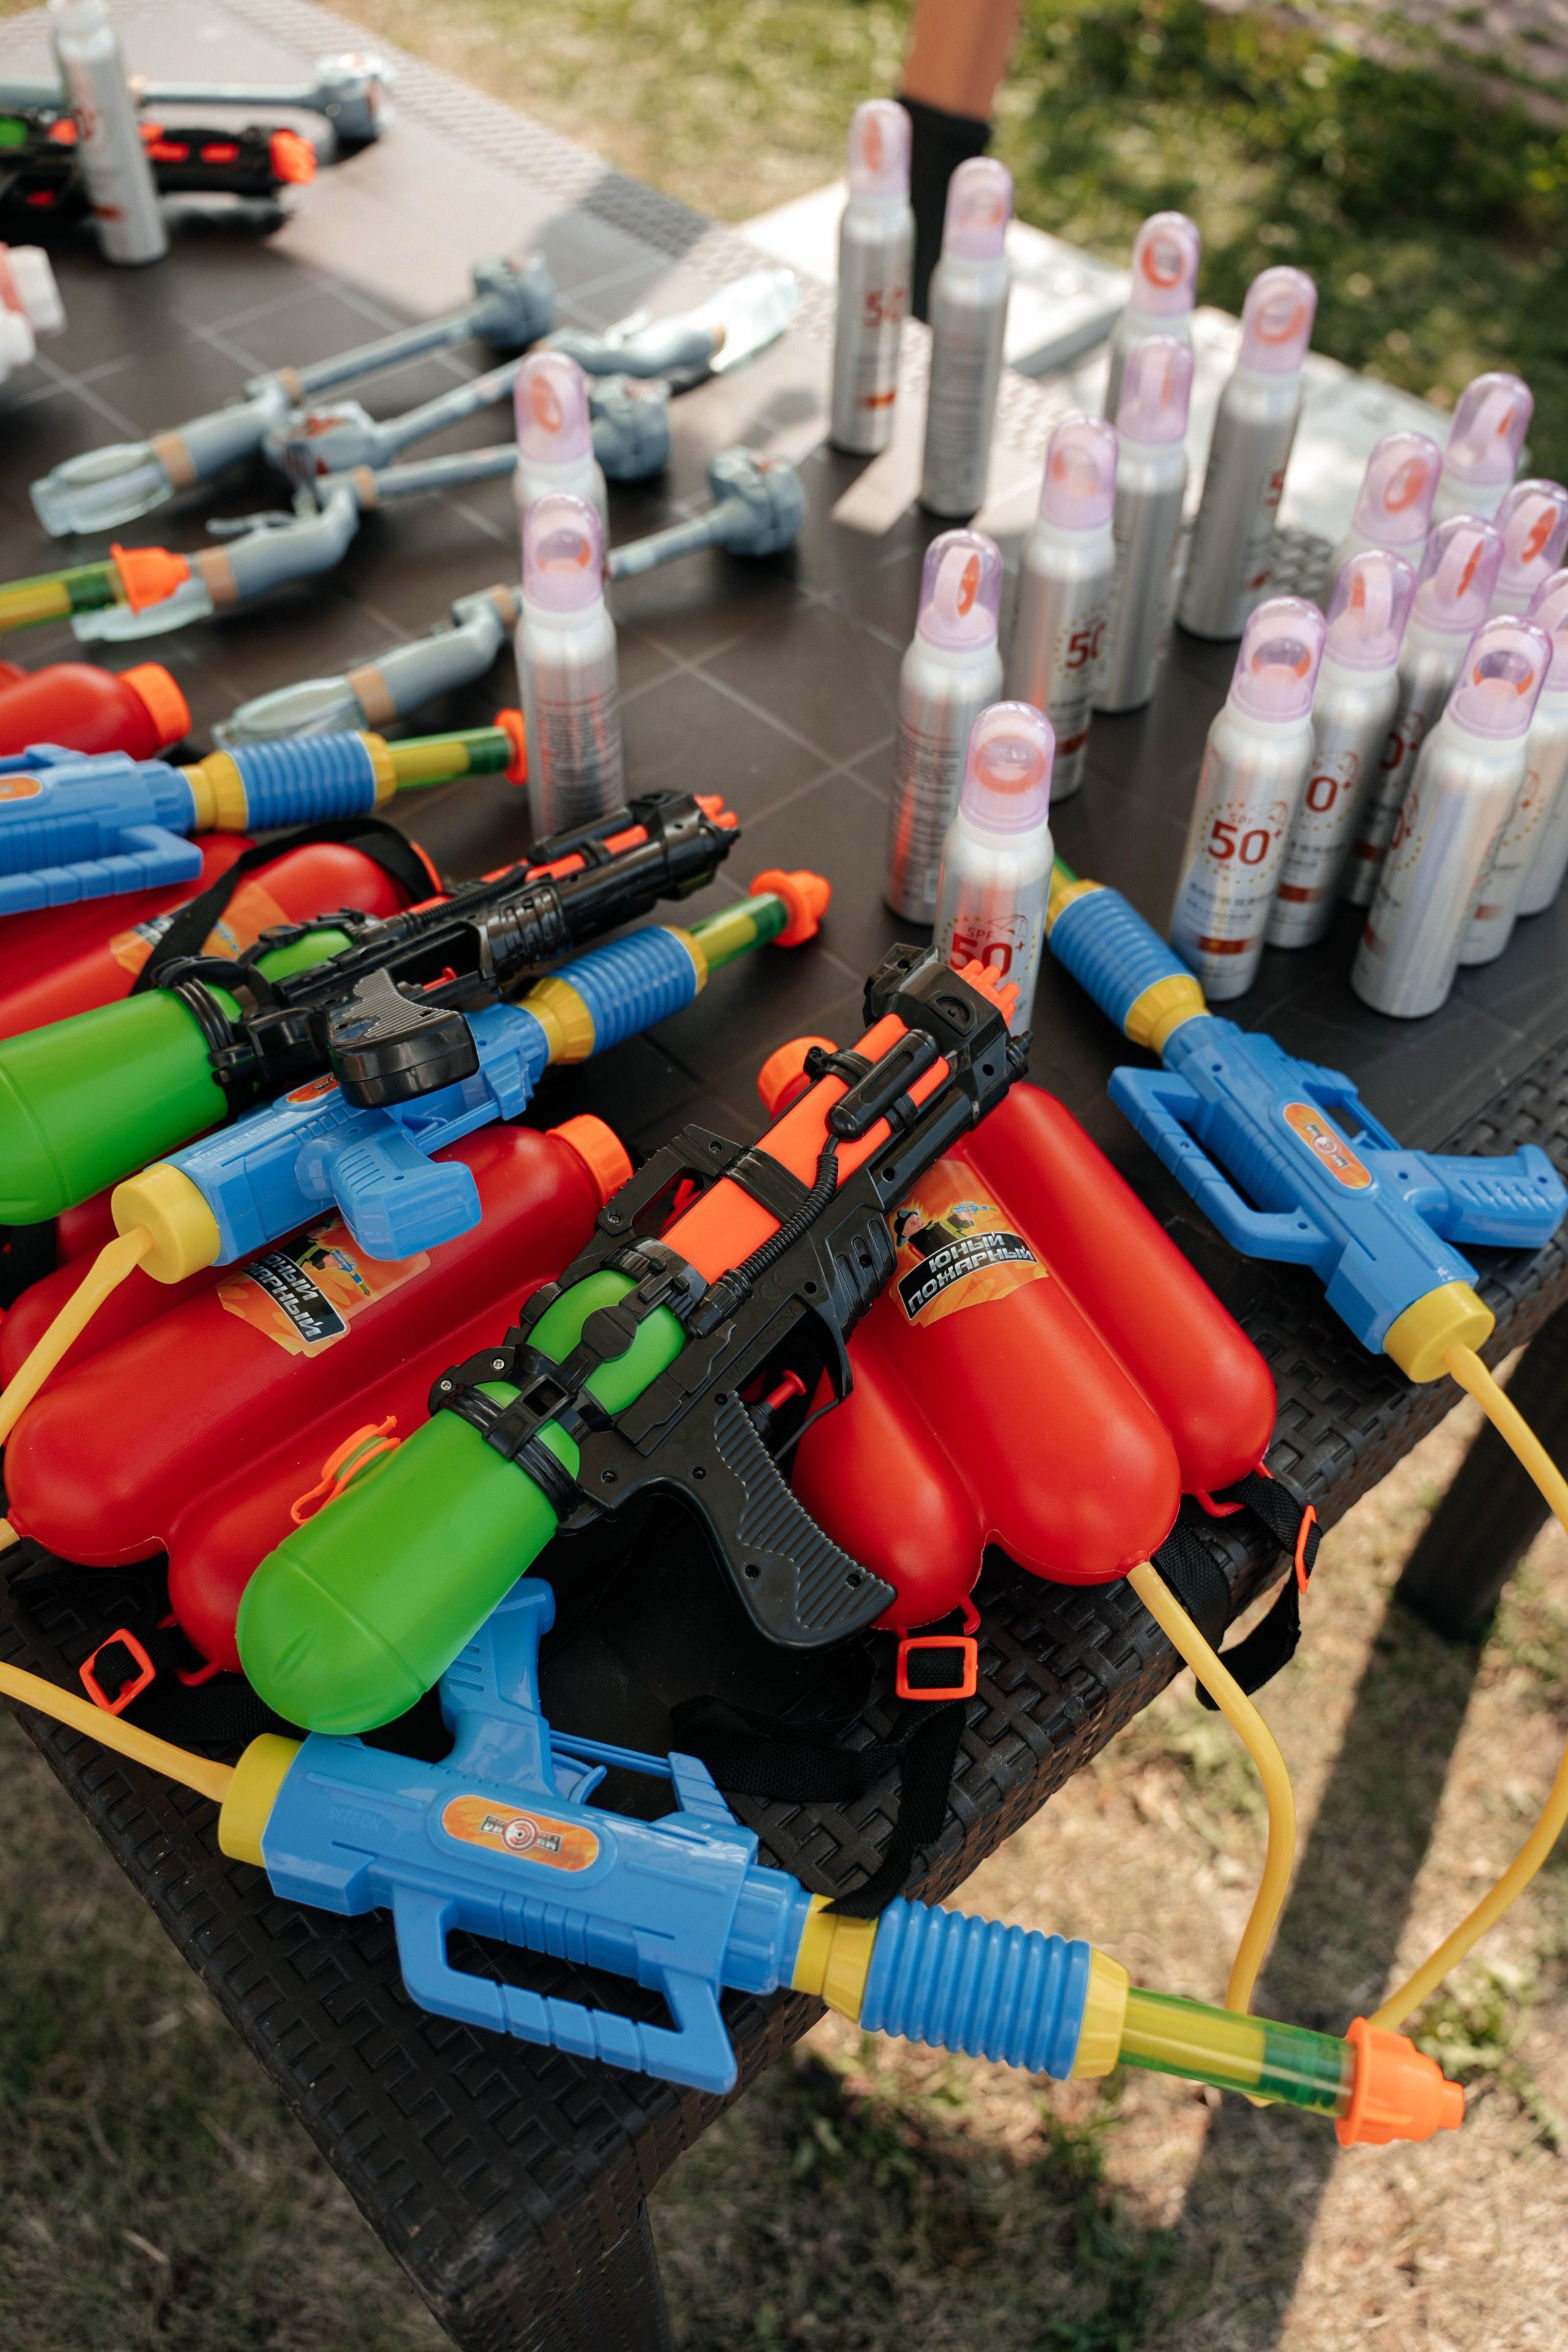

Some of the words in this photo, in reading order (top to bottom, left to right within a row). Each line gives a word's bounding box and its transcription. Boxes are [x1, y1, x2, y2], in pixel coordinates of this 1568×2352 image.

[967, 927, 995, 941] SPF
[908, 1245, 1034, 1313] ПОЖАРНЫЙ
[929, 1232, 1005, 1273] ЮНЫЙ
[725, 1349, 758, 1382] MADE
[755, 1336, 771, 1351] IN
[767, 1306, 799, 1338] CHINA
